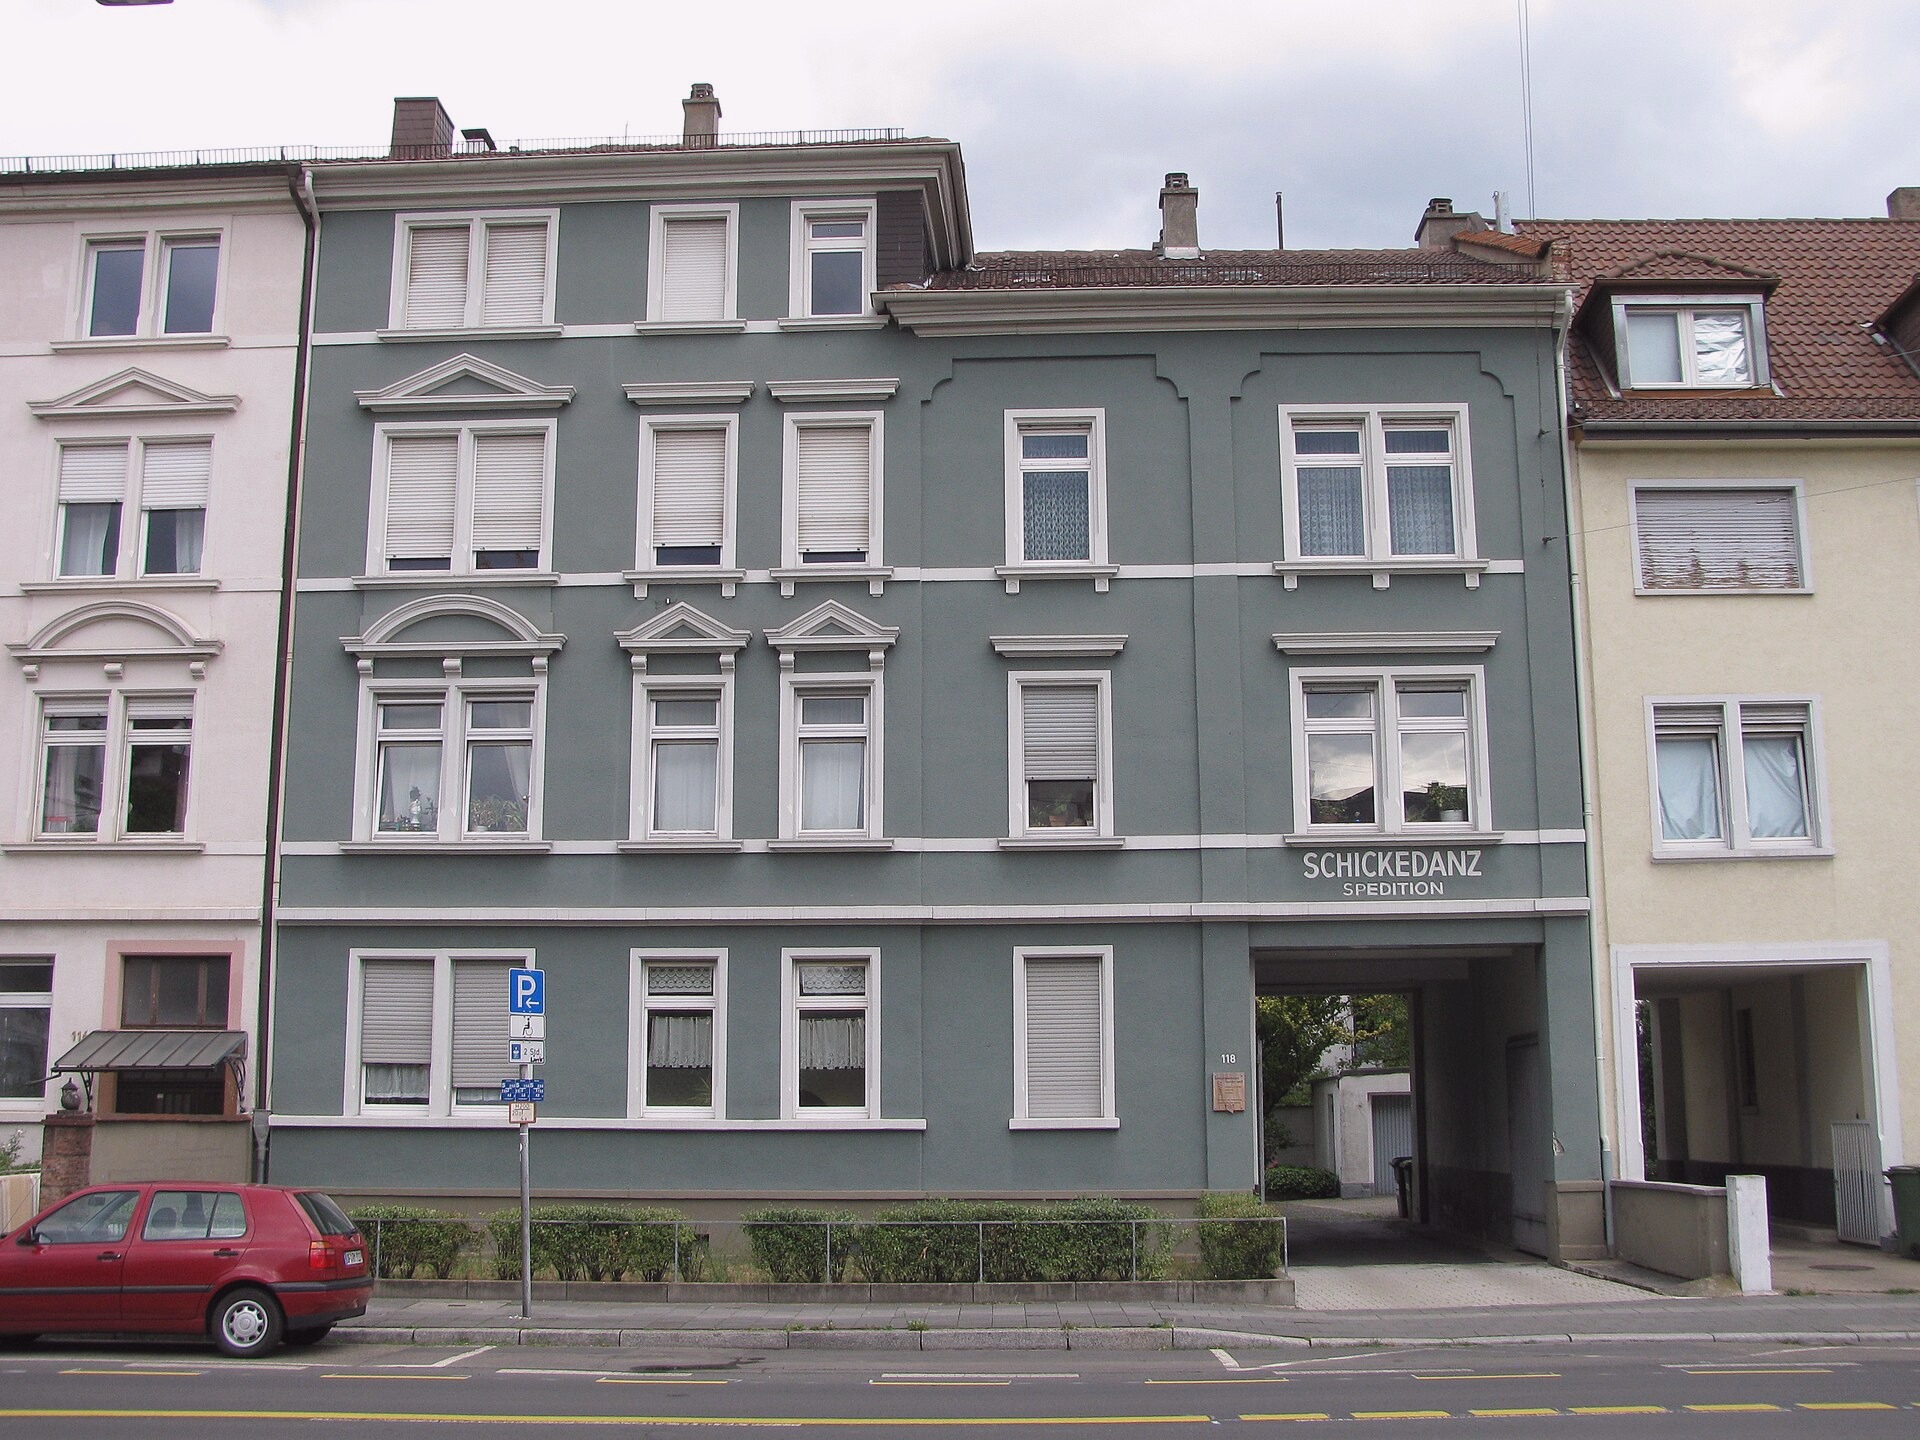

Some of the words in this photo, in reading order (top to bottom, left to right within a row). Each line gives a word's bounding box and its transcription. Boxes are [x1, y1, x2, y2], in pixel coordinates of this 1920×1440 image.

[1303, 850, 1482, 879] SCHICKEDANZ
[1343, 881, 1444, 896] SPEDITION
[517, 974, 537, 1008] P
[523, 1047, 528, 1056] 2
[1221, 1054, 1236, 1064] 118
